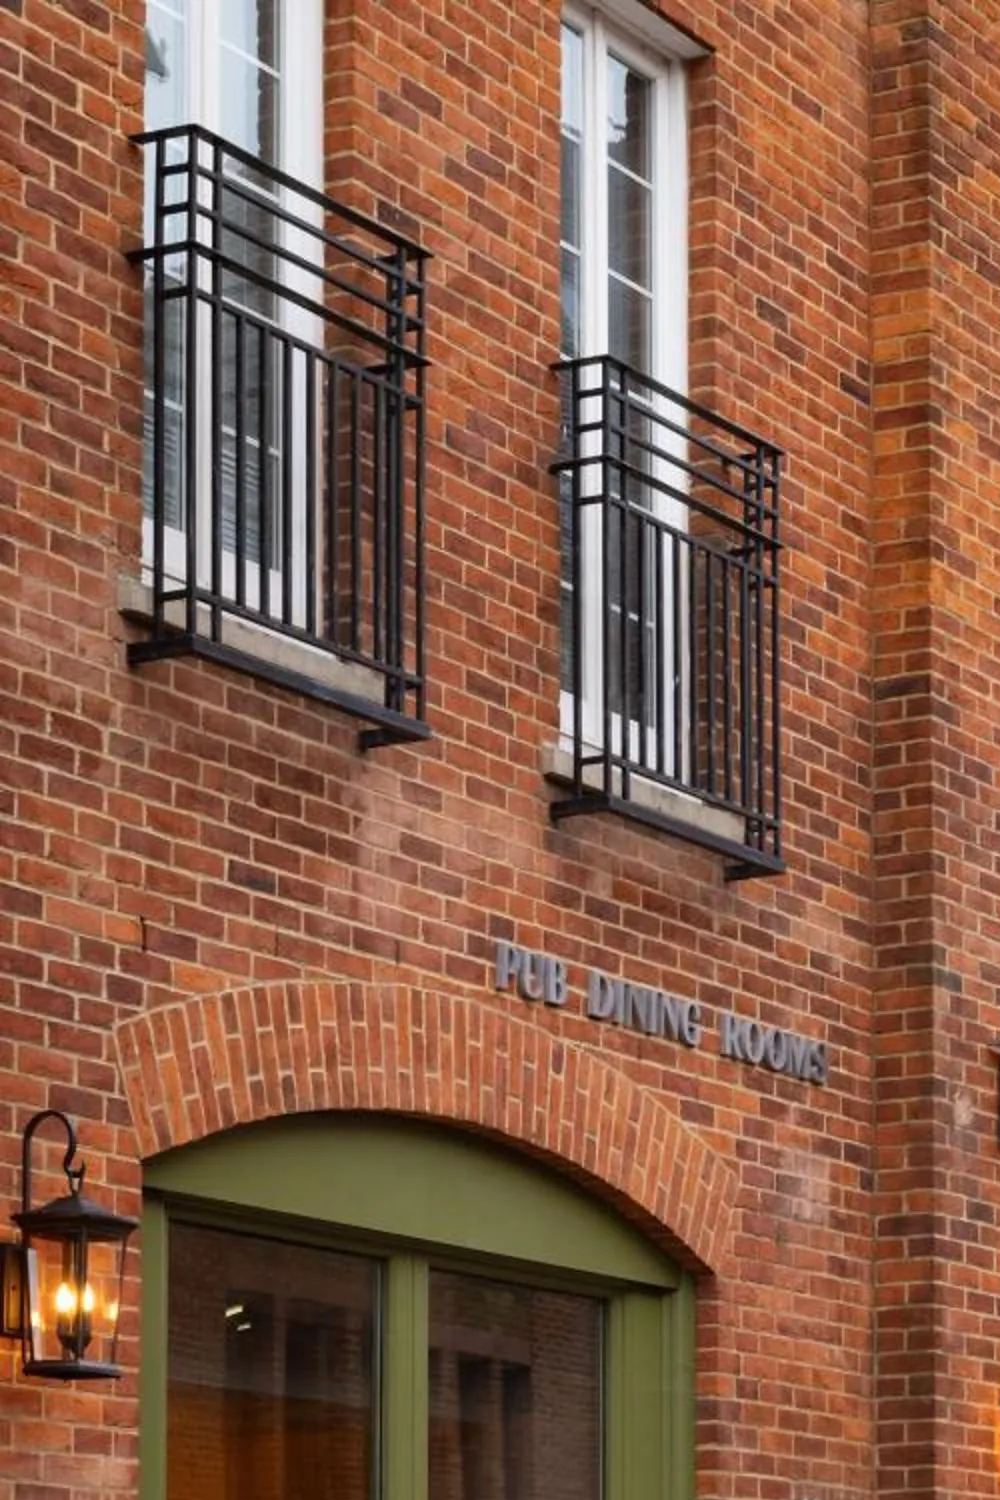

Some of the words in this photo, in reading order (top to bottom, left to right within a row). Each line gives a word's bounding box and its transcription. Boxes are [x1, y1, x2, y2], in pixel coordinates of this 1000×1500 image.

[494, 938, 568, 1006] PUB
[586, 967, 701, 1048] DINING
[720, 1009, 829, 1086] ROOMS
